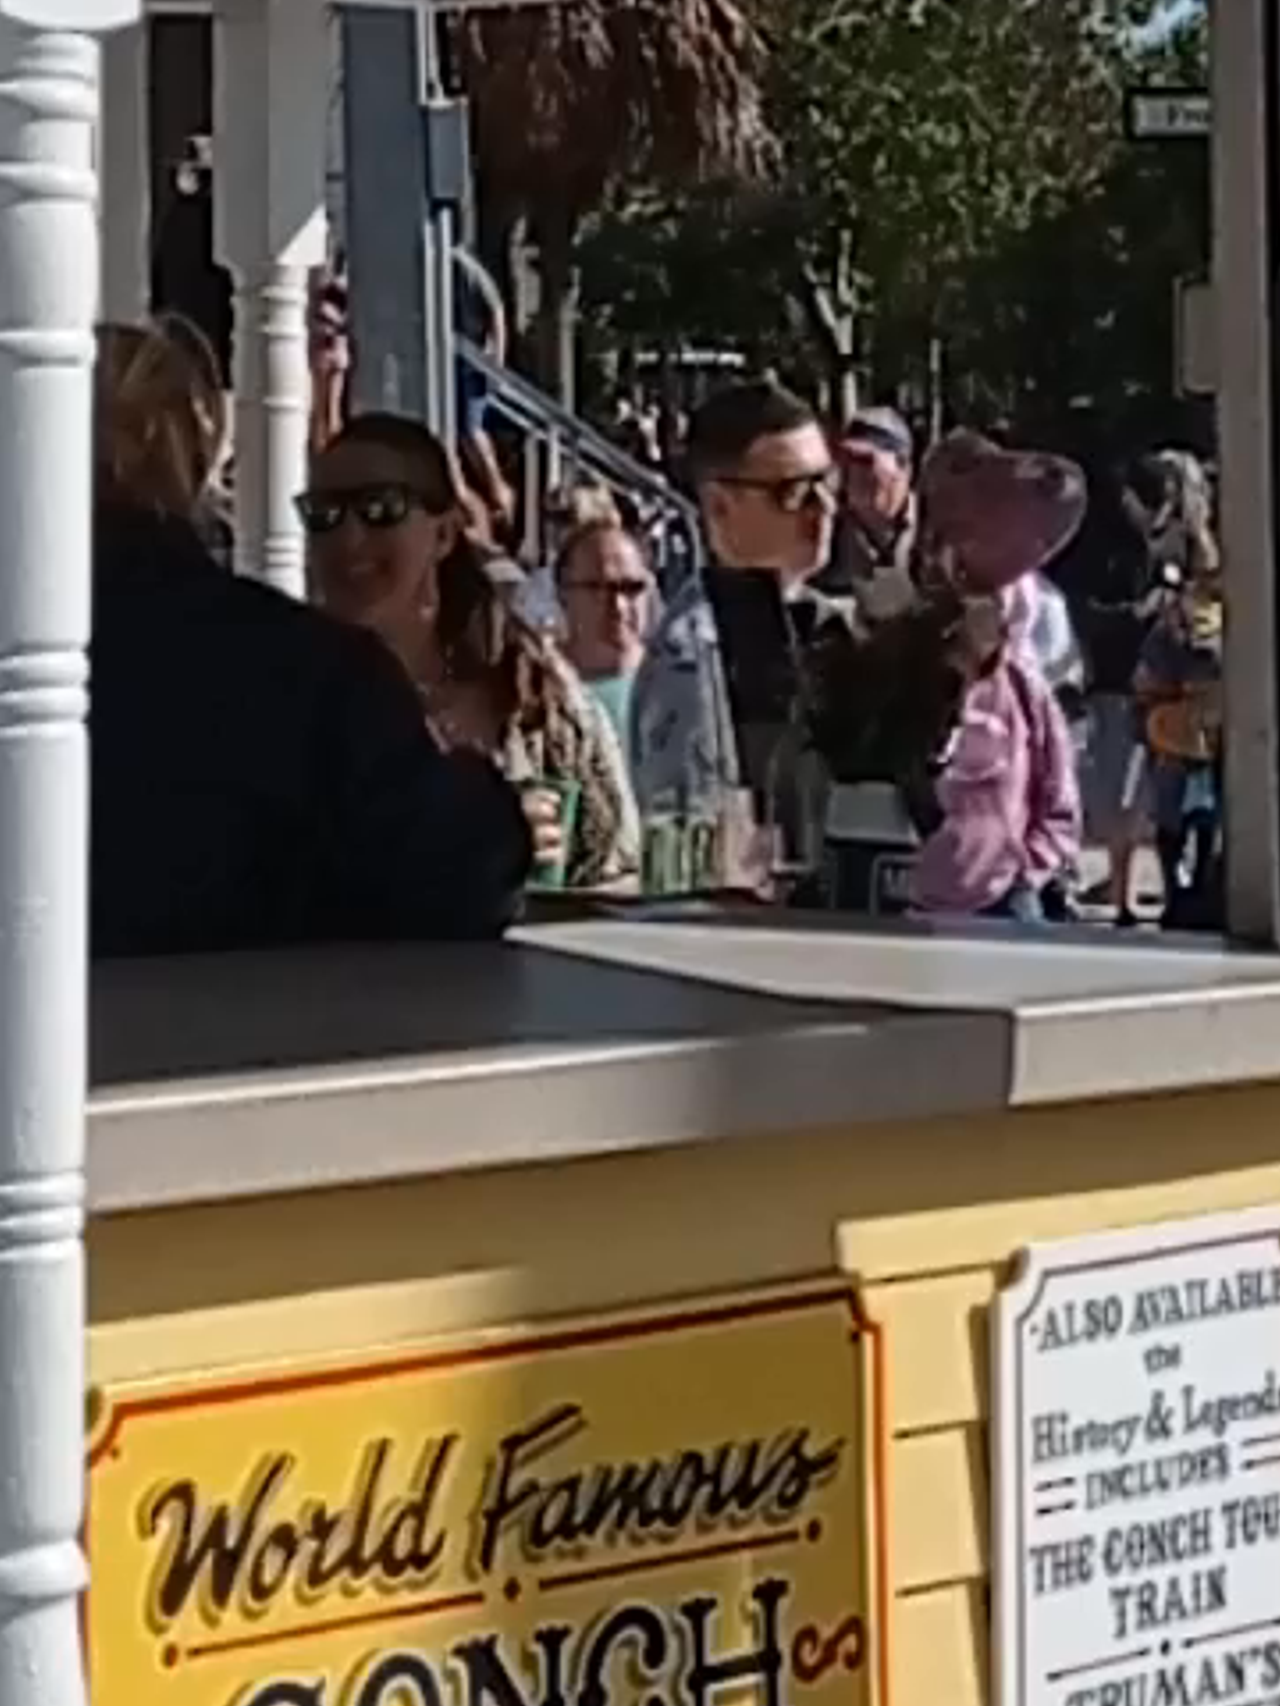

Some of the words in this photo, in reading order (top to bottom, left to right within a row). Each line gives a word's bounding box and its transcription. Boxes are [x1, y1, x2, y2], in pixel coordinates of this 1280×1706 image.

[1037, 1295, 1122, 1352] ALSO
[1144, 1343, 1181, 1375] the
[1032, 1410, 1141, 1464] History
[1145, 1390, 1173, 1441] &
[140, 1434, 457, 1622] World
[478, 1404, 845, 1576] Famous
[1086, 1442, 1230, 1510] INCLUDES
[1030, 1535, 1094, 1596] THE
[1103, 1508, 1212, 1574] CONCH
[1109, 1564, 1226, 1639] TRAIN
